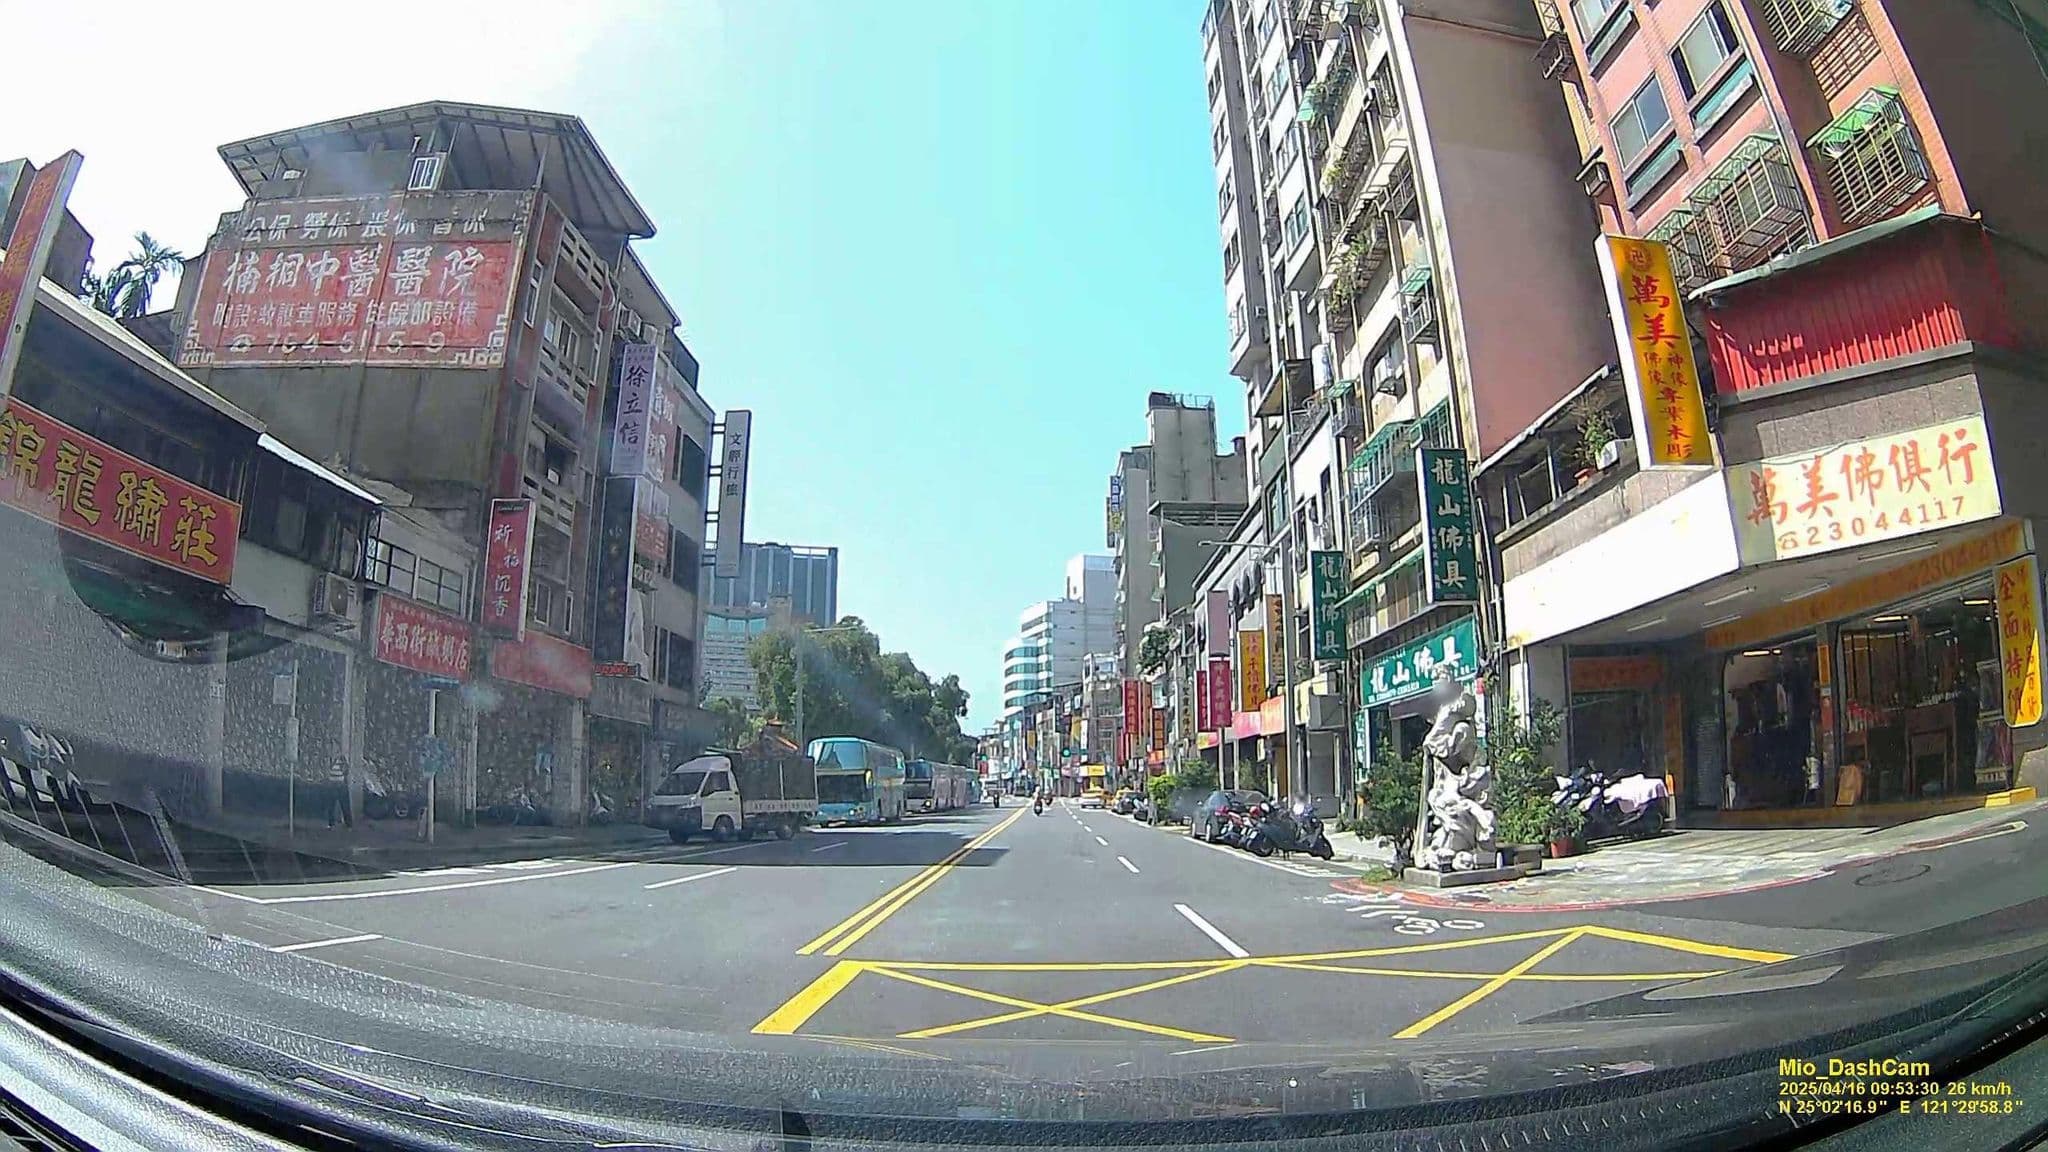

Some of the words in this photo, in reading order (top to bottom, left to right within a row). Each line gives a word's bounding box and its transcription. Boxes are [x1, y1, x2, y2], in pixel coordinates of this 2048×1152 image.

[1629, 274, 1682, 348] 萬美
[619, 364, 649, 445] 徐立信
[0, 410, 219, 567] 錦龍繡莊
[1747, 428, 1978, 526] 萬美佛俱行
[1807, 496, 1965, 546] 23044117
[1431, 457, 1467, 589] 龍山佛具
[1317, 555, 1341, 655] 龍山佛具
[1370, 635, 1463, 694] 龍山佛具
